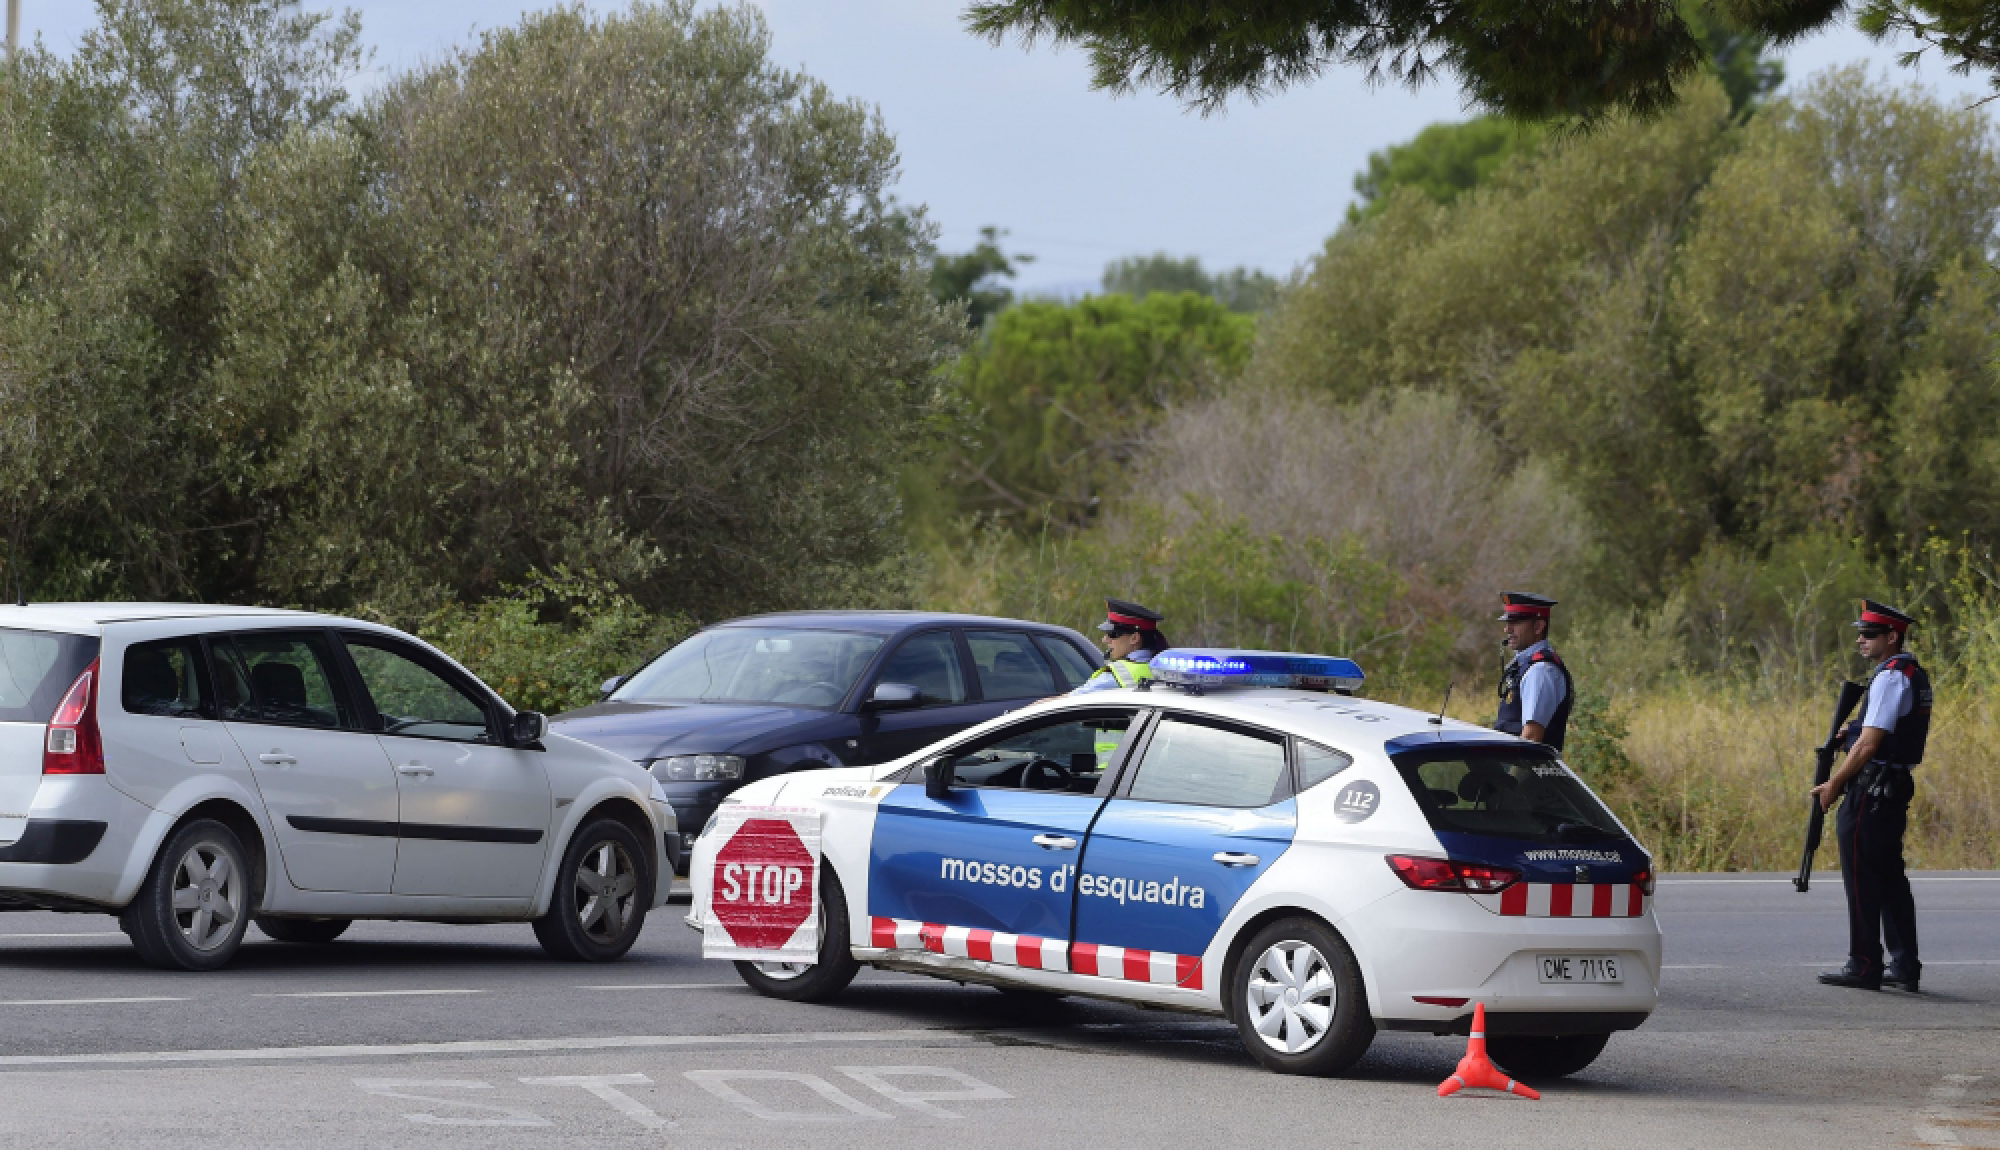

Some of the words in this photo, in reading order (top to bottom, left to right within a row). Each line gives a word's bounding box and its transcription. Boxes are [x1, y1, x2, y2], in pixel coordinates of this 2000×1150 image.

[1342, 790, 1374, 808] 112
[722, 862, 803, 904] STOP
[941, 857, 1042, 890] mossos
[1543, 957, 1572, 980] CME
[1579, 958, 1617, 980] 7116
[351, 1064, 1016, 1131] STOP
